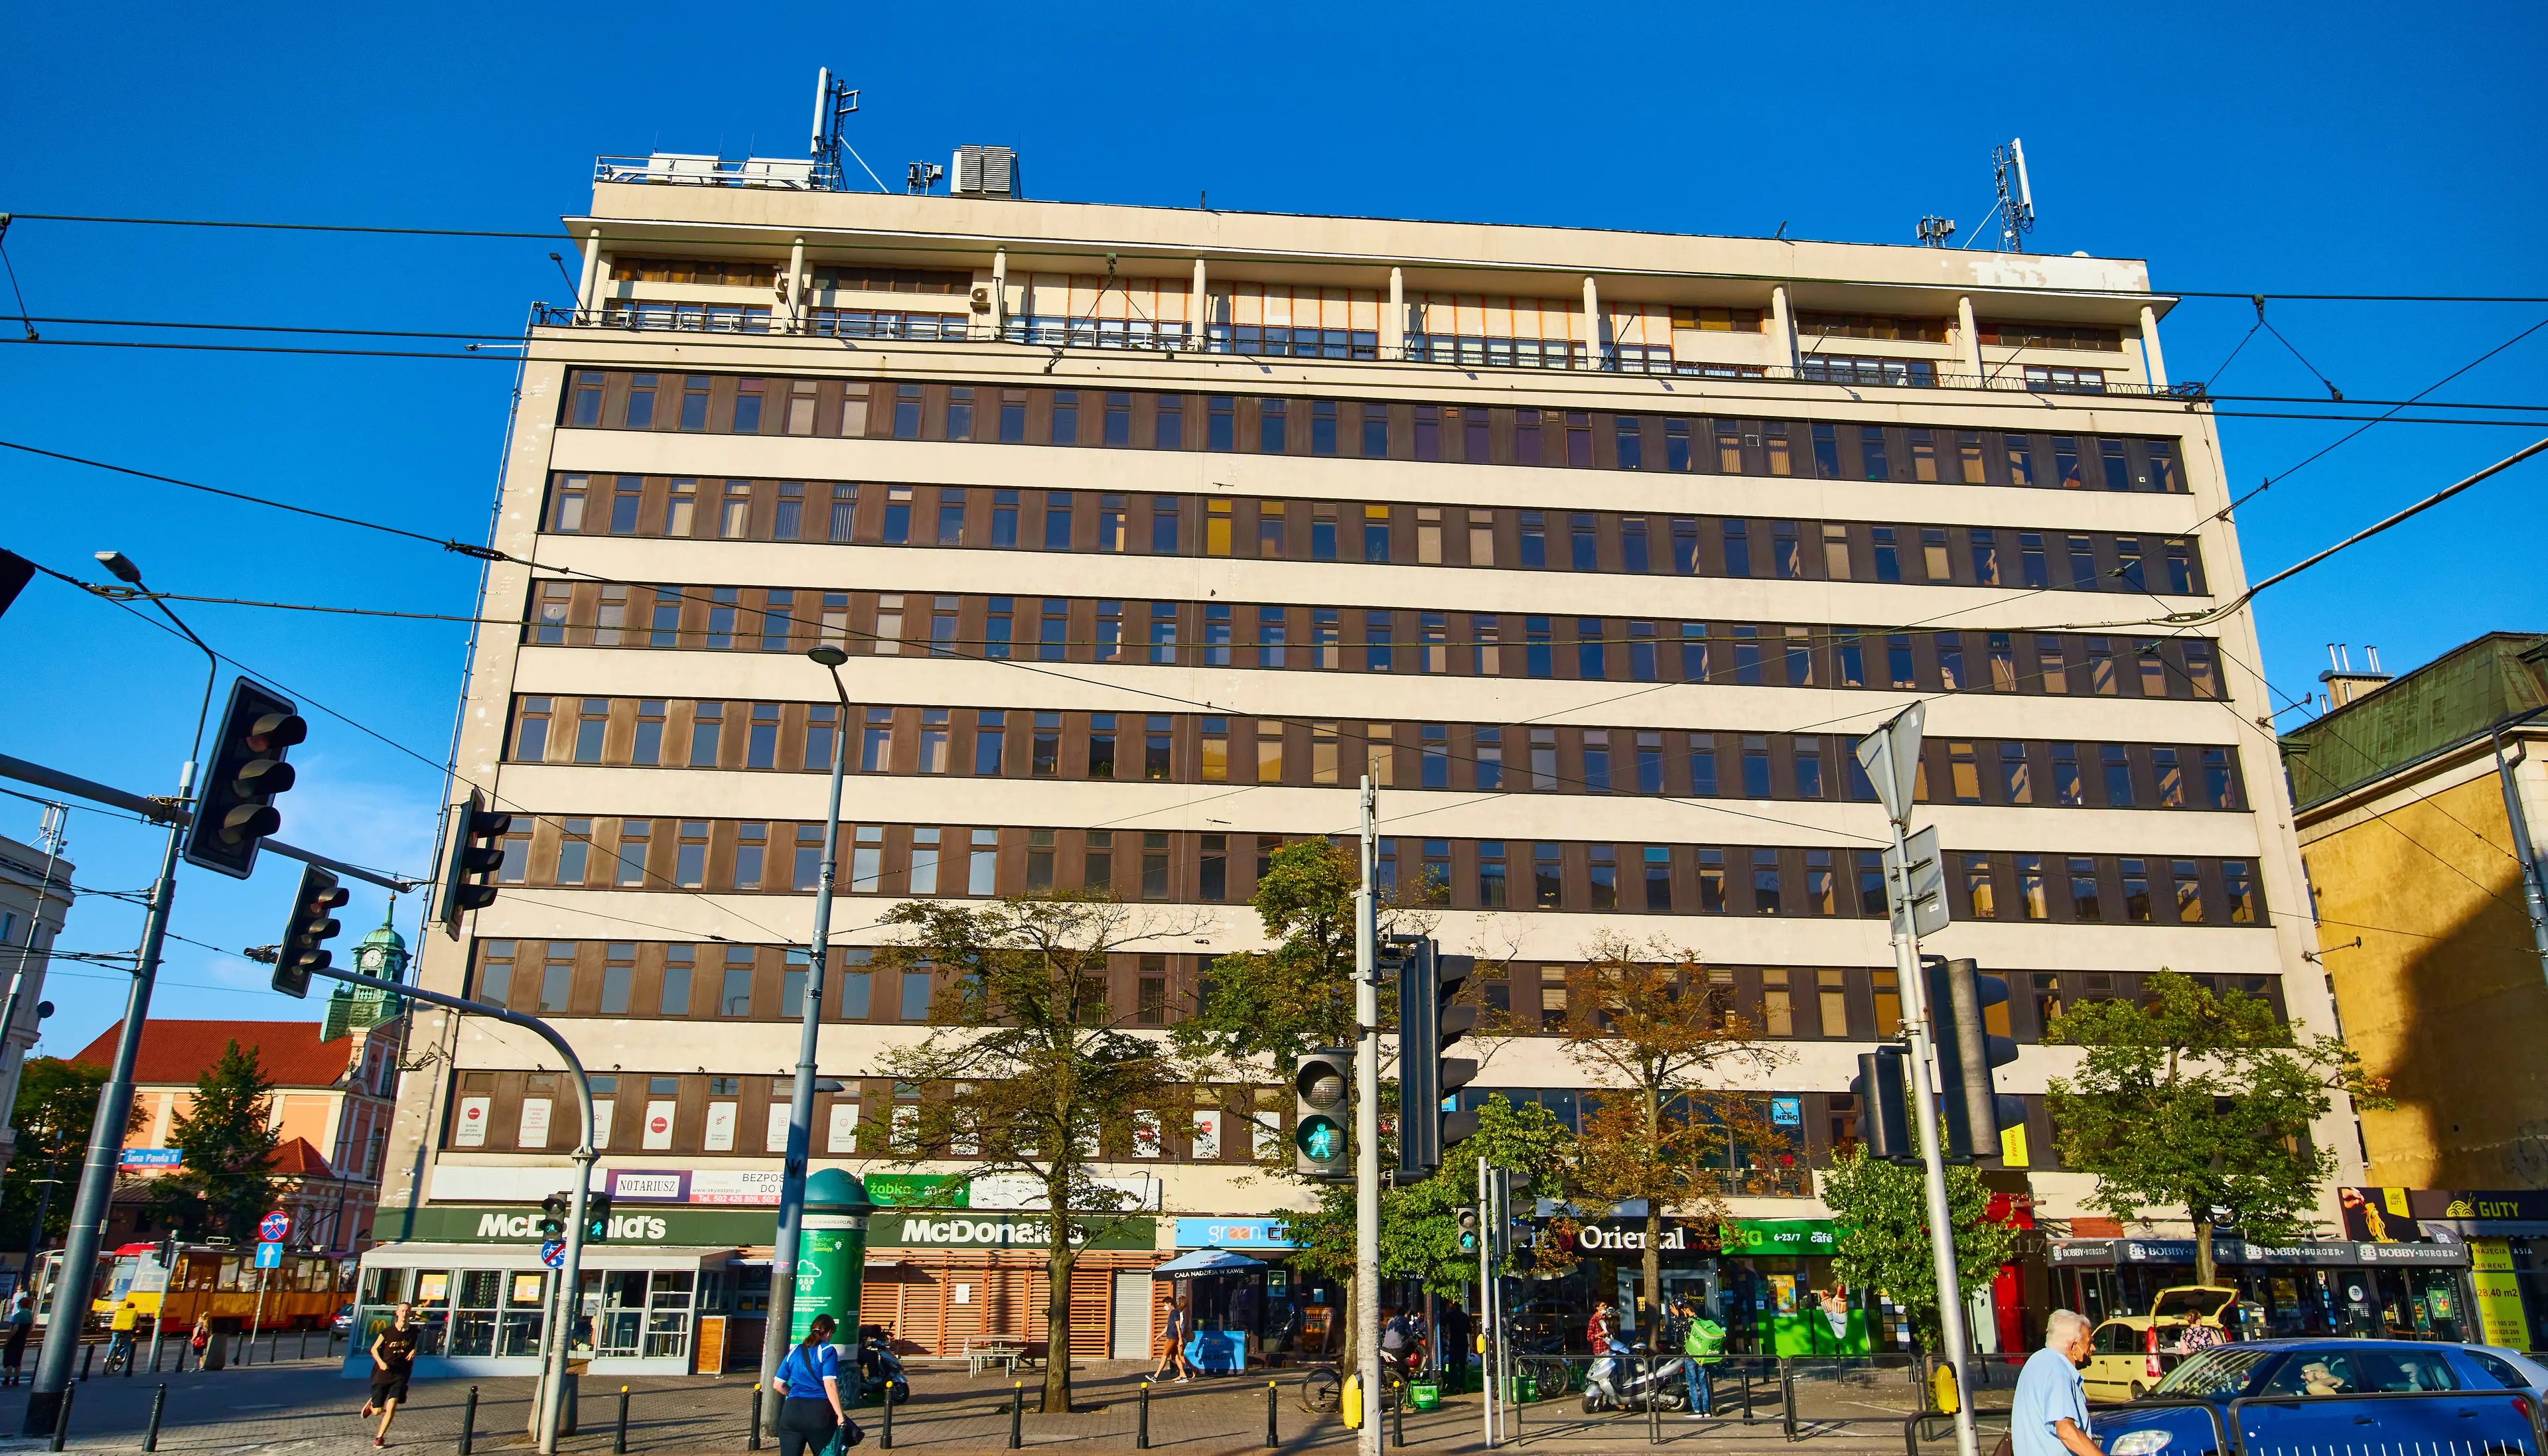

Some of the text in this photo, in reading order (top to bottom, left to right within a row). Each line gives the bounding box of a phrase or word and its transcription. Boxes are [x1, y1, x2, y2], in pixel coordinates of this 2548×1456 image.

[145, 1154, 169, 1162] Pawła
[743, 1172, 784, 1182] BEZPOŚ
[619, 1180, 675, 1191] NOTARIUSZ
[760, 1184, 776, 1193] DO
[2478, 1201, 2519, 1218] GUTY
[476, 1214, 667, 1239] McDld's
[1208, 1225, 1261, 1243] green
[1774, 1233, 1801, 1242] 6-23/7
[1810, 1233, 1833, 1243] café
[2015, 1238, 2045, 1253] 117
[2062, 1248, 2084, 1257] BOBBY
[2149, 1247, 2184, 1256] BOBBY
[2378, 1248, 2416, 1258] BOBBY
[2418, 1249, 2455, 1258] BURGER
[2477, 1288, 2518, 1298] 28,40 m2
[1691, 1330, 1703, 1343] Uber
[1689, 1335, 1701, 1349] Eats
